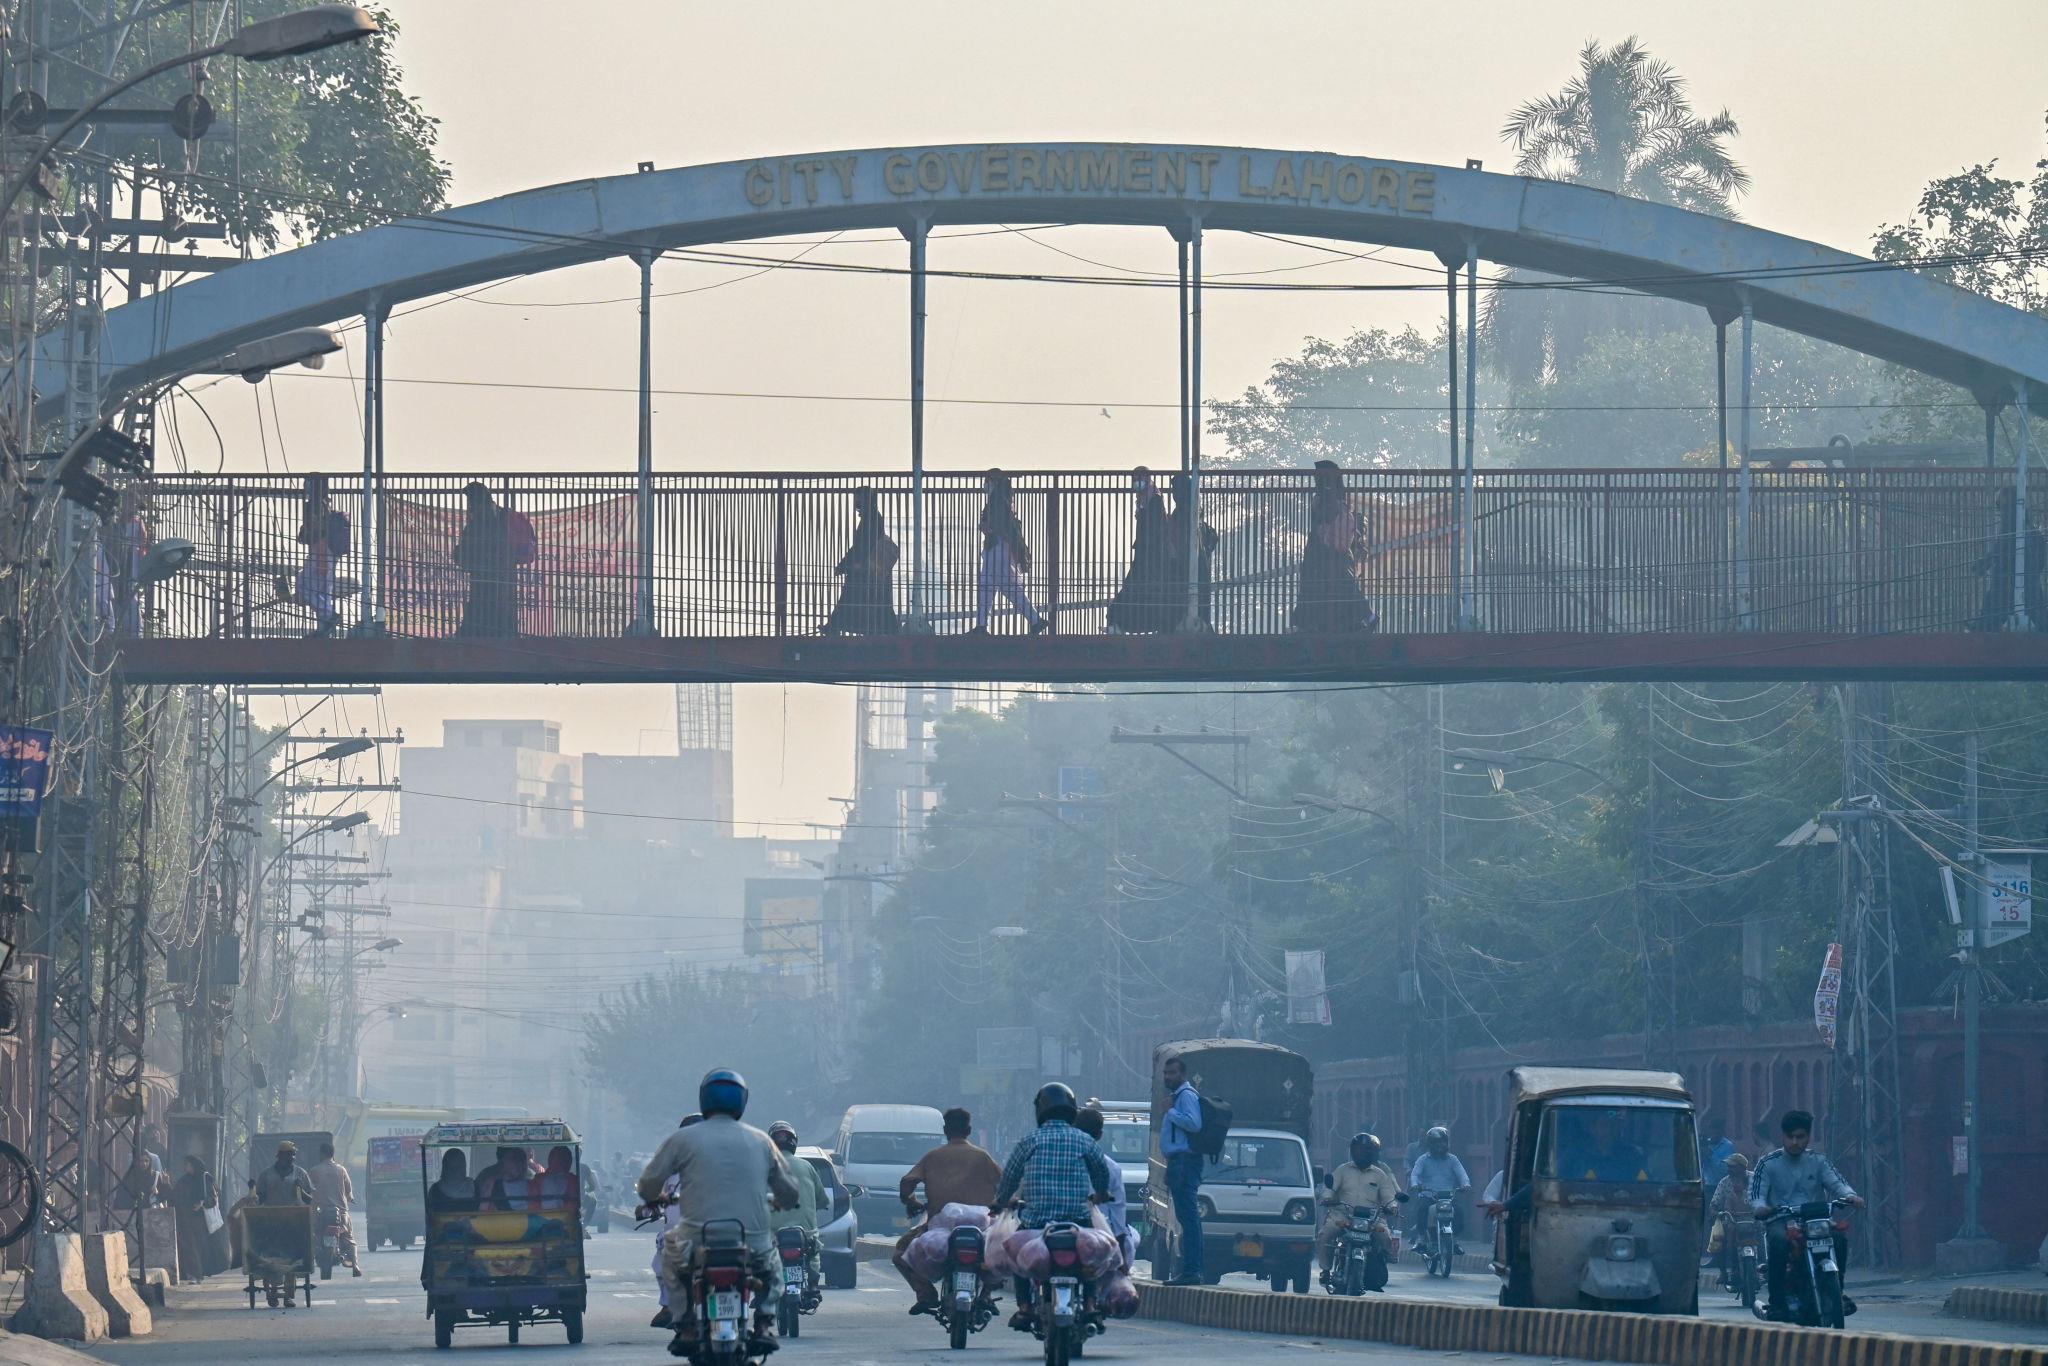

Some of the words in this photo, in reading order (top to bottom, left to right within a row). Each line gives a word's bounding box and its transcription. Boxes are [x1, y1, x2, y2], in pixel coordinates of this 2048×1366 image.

[744, 155, 858, 206] CITY
[884, 147, 1220, 196] GOVERNMENT
[1239, 154, 1435, 213] LAHORE
[2000, 905, 2020, 921] 15
